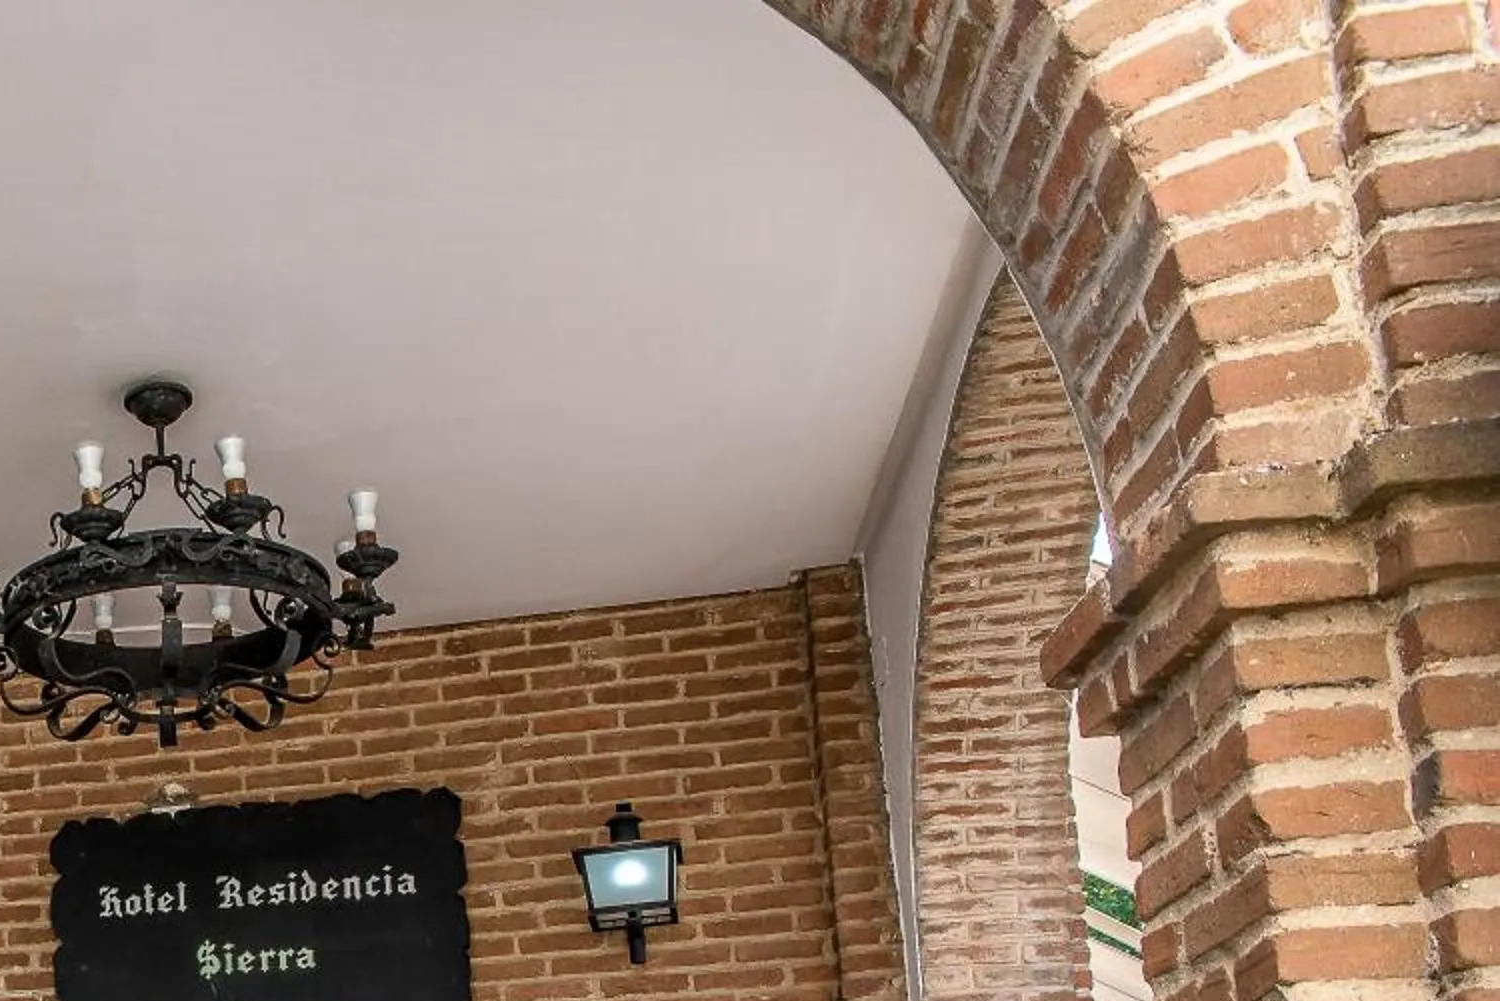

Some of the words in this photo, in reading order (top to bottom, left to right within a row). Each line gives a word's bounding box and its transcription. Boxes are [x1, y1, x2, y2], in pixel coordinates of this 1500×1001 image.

[99, 881, 187, 917] Hotel
[216, 864, 416, 908] Residencia
[196, 939, 316, 980] Sierra
